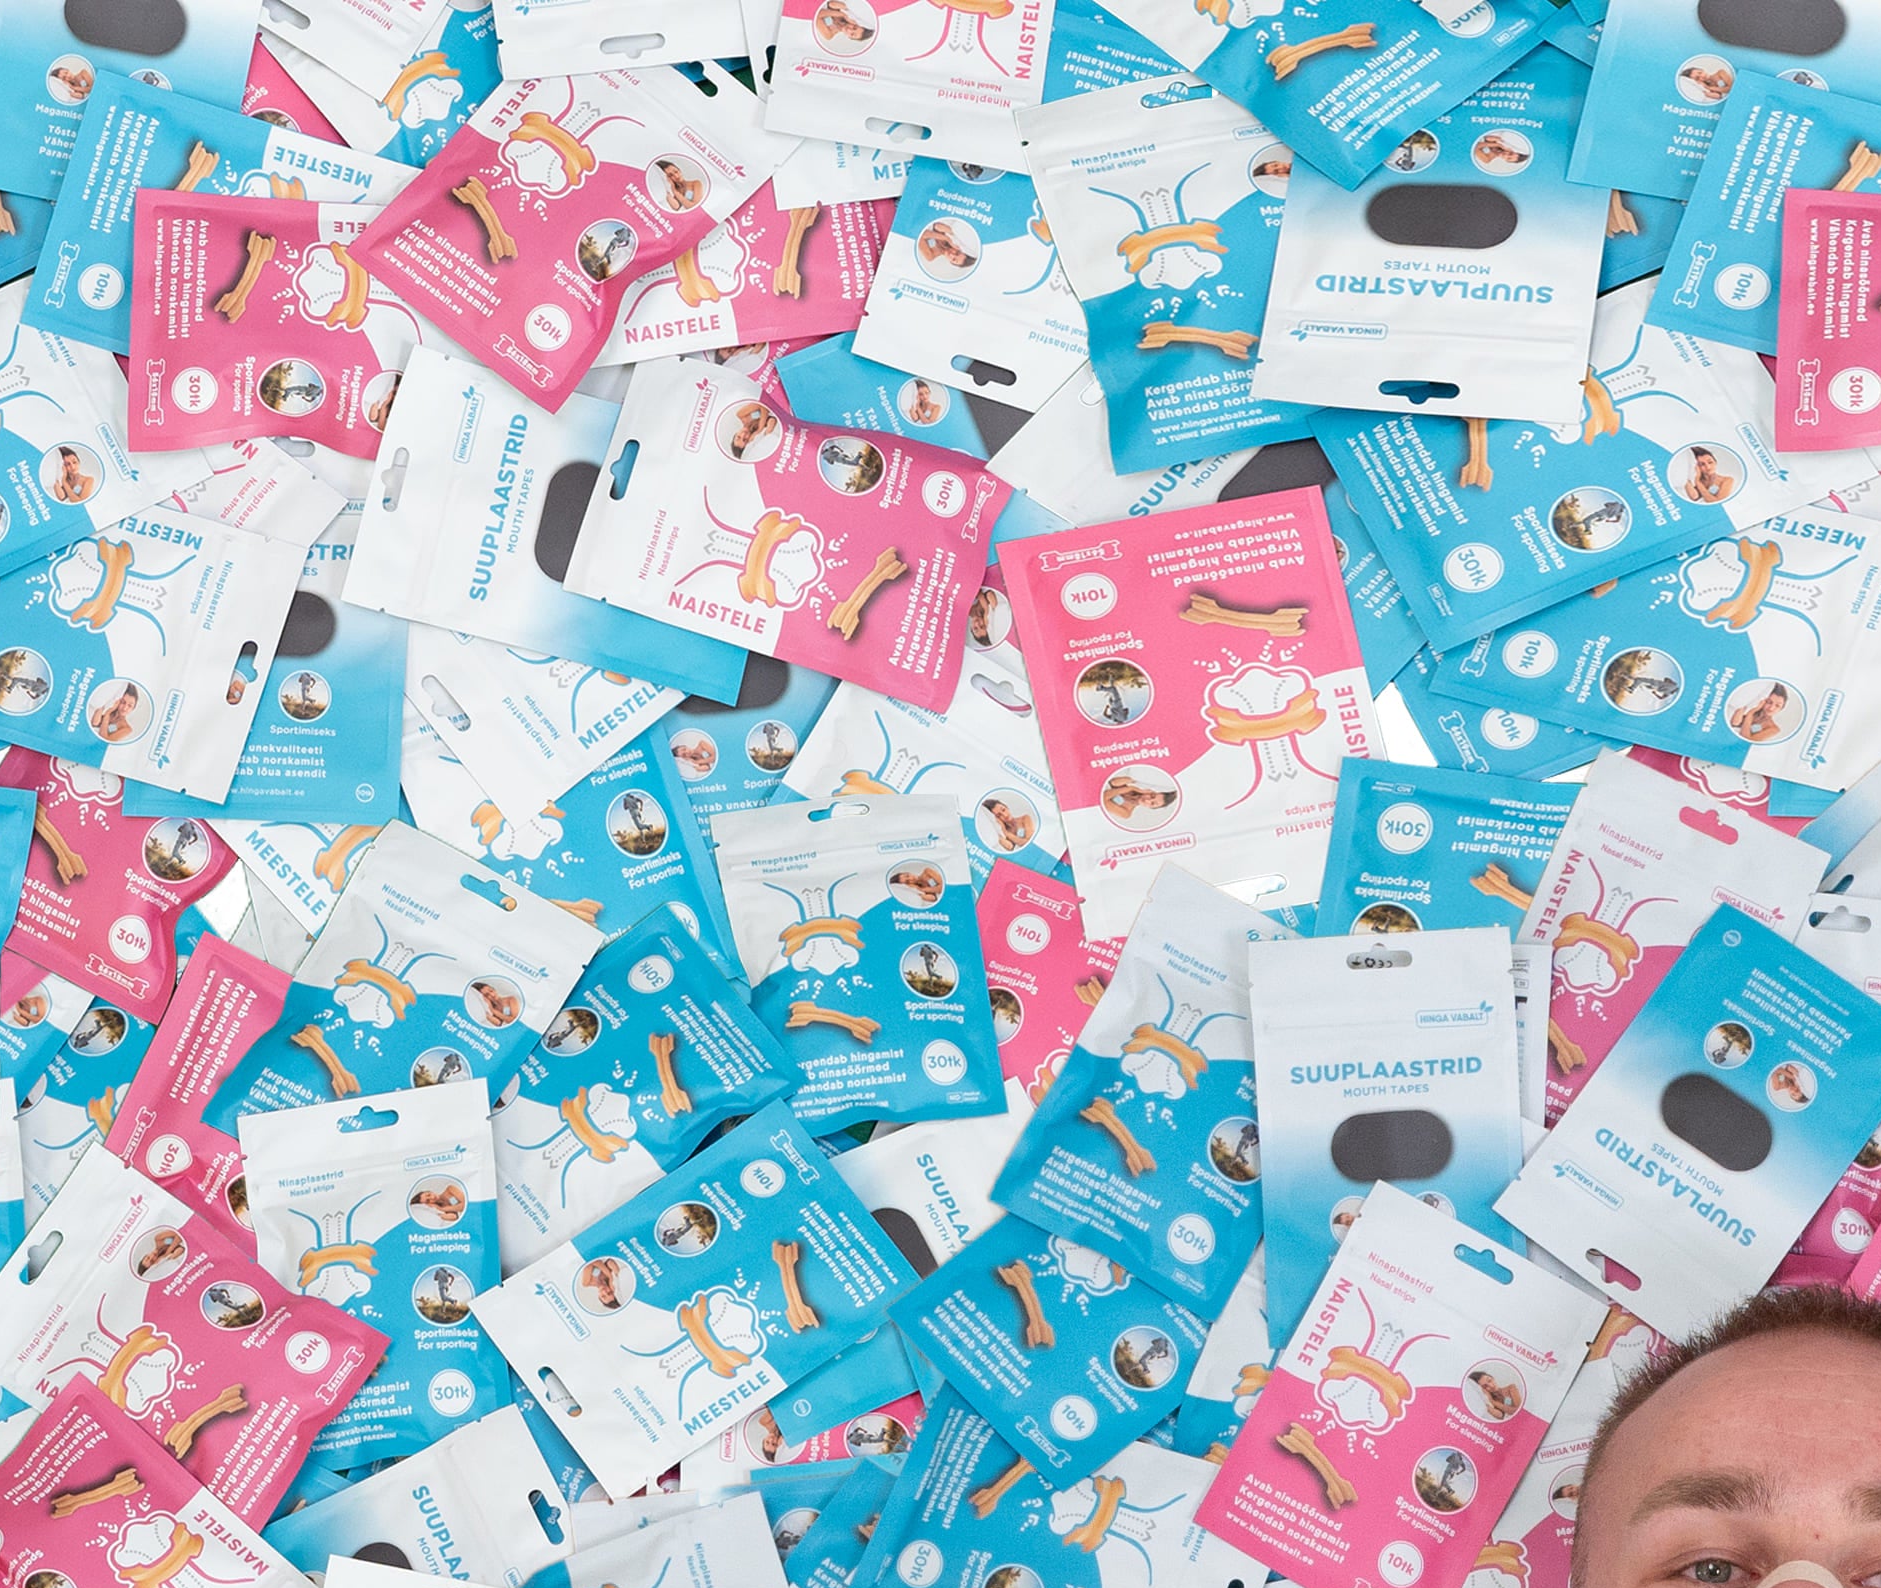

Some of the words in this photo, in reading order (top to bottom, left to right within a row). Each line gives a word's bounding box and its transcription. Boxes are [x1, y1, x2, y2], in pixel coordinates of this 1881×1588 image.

[1383, 260, 1431, 272] TAPES
[1436, 263, 1491, 275] MOUTH
[1315, 274, 1554, 304] SUUPLAASTRID
[188, 375, 201, 408] 30tk
[245, 829, 327, 917] MEESTELE
[891, 910, 950, 922] Magamiseks
[904, 1000, 965, 1012] Sportimiseks
[1419, 1013, 1449, 1024] HINGA
[1450, 1012, 1484, 1022] VABALT
[444, 1009, 500, 1051] Magamiseks
[928, 1055, 962, 1069] 30tk
[1290, 1056, 1482, 1085] SUUPLAASTRID
[1343, 1085, 1387, 1098] MOUTH
[1390, 1083, 1430, 1094] TAPES
[414, 1327, 479, 1341] Sportimiseks
[193, 1509, 270, 1576] NAISTELE
